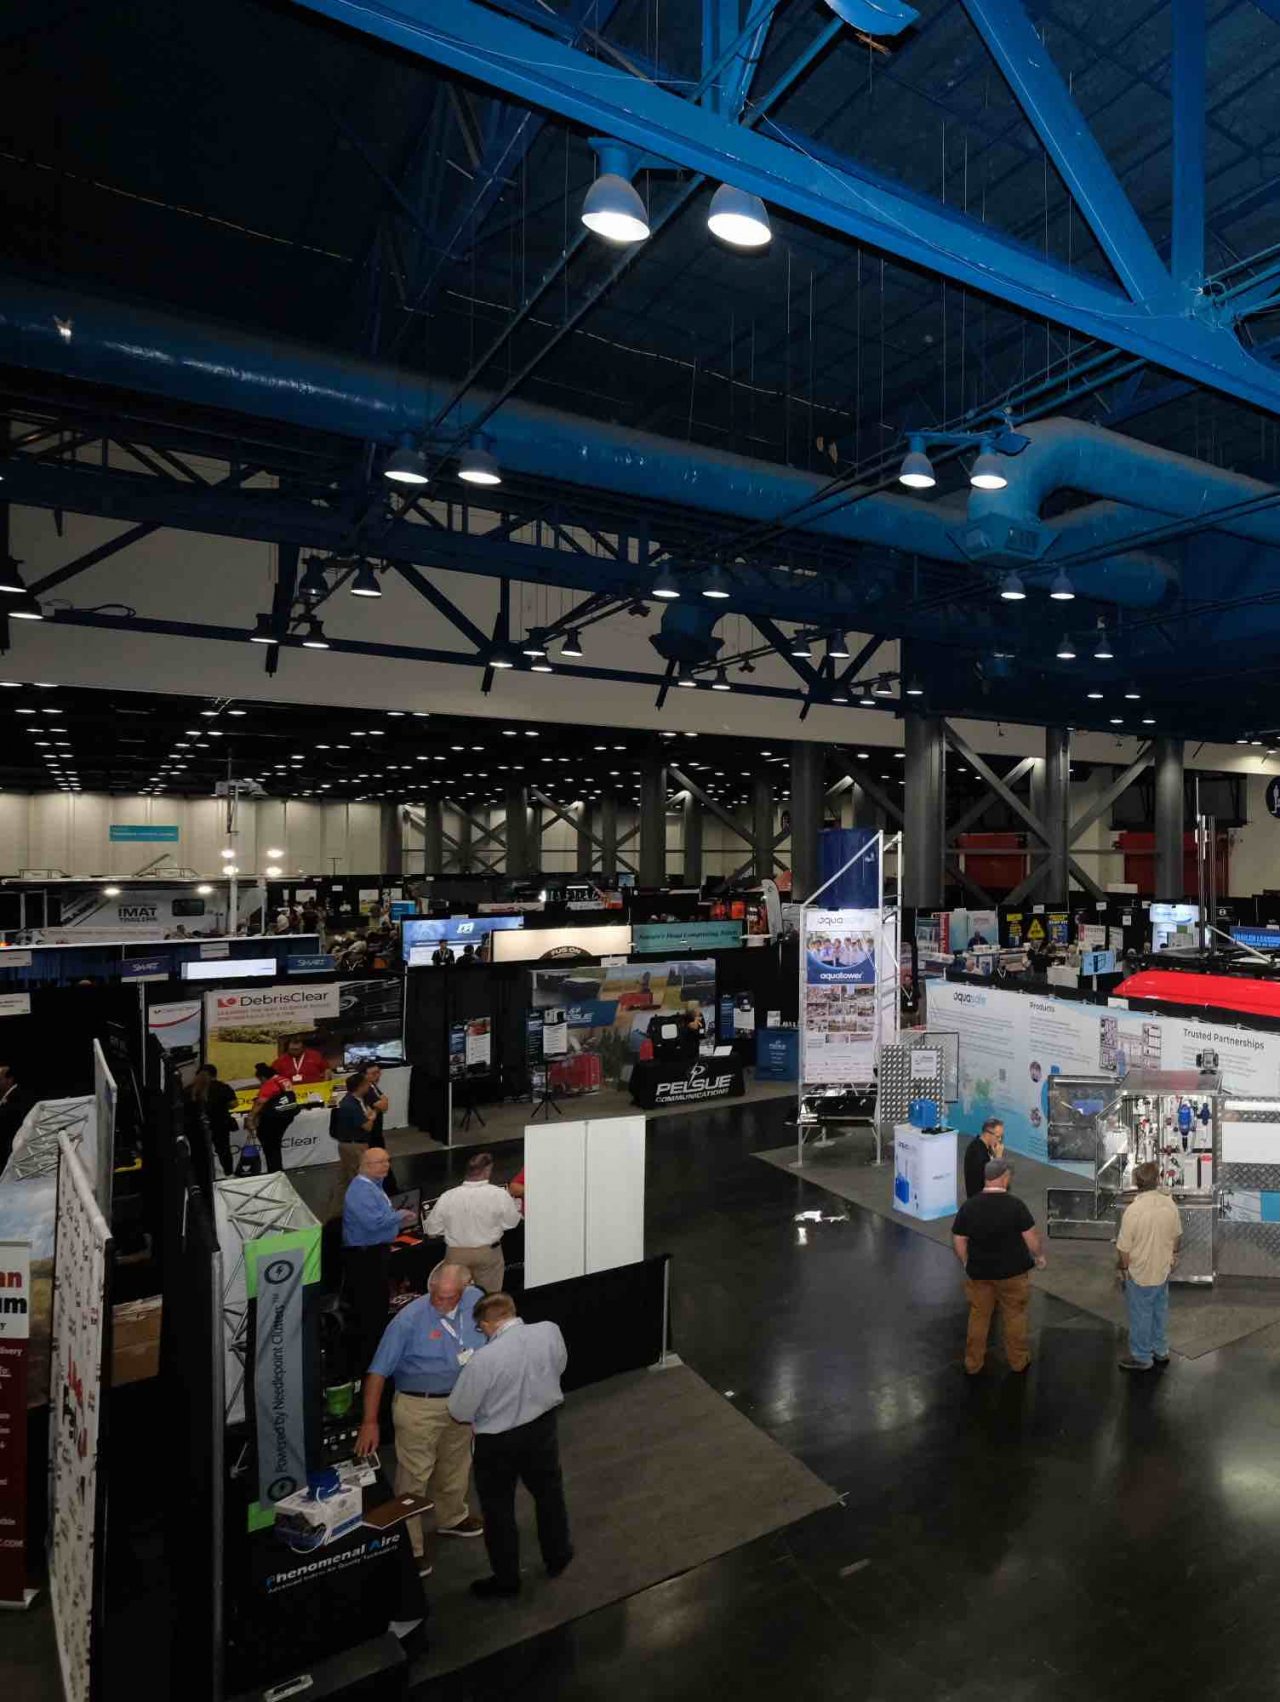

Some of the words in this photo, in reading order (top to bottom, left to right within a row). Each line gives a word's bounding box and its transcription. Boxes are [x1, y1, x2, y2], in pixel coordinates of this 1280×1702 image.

[239, 991, 329, 1007] DebrisClear
[1183, 1028, 1212, 1042] Trusted
[1213, 1034, 1265, 1051] Partnerships
[655, 1074, 735, 1096] PELSUE
[655, 1088, 730, 1103] COMMUNICATIONS
[271, 1347, 284, 1411] Needlepoint
[263, 1544, 366, 1589] Phenomenal
